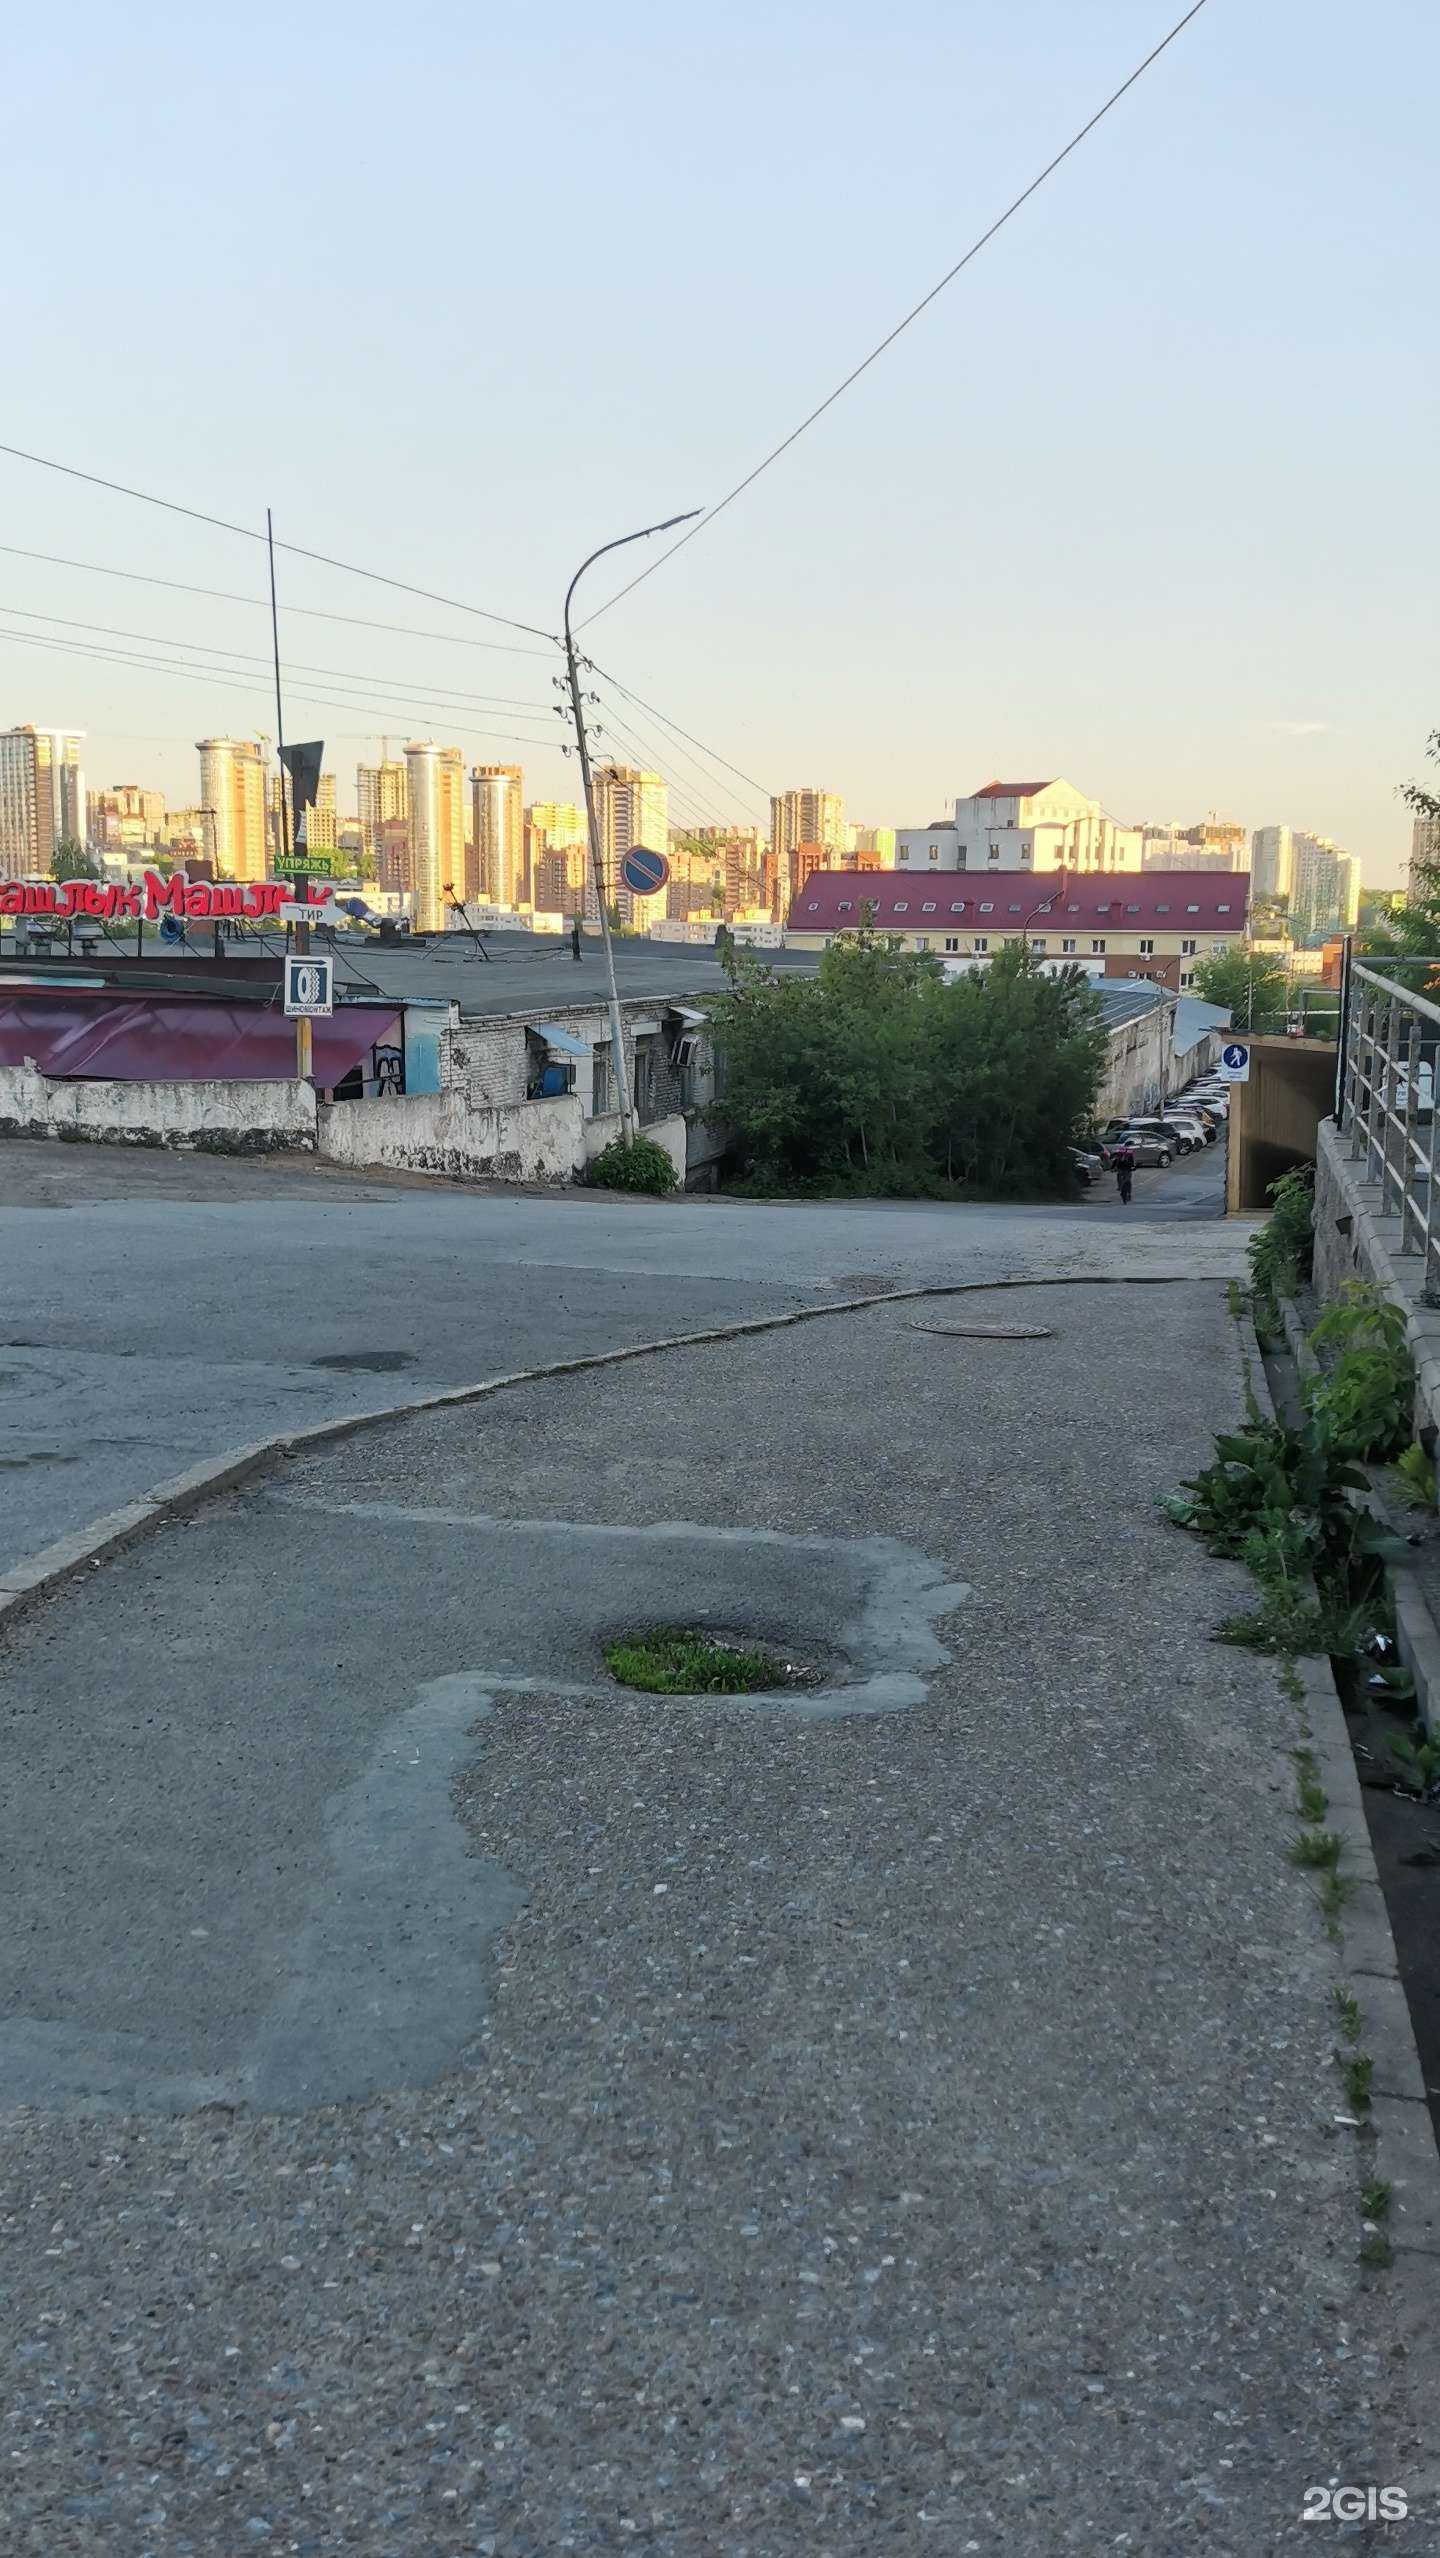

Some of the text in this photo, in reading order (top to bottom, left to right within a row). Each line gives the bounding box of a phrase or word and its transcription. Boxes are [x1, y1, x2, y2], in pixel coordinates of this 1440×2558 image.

[277, 856, 329, 870] УПРЯЖЬ
[299, 909, 323, 921] ТИР
[286, 1005, 332, 1013] ШИНОМОНТАЖ
